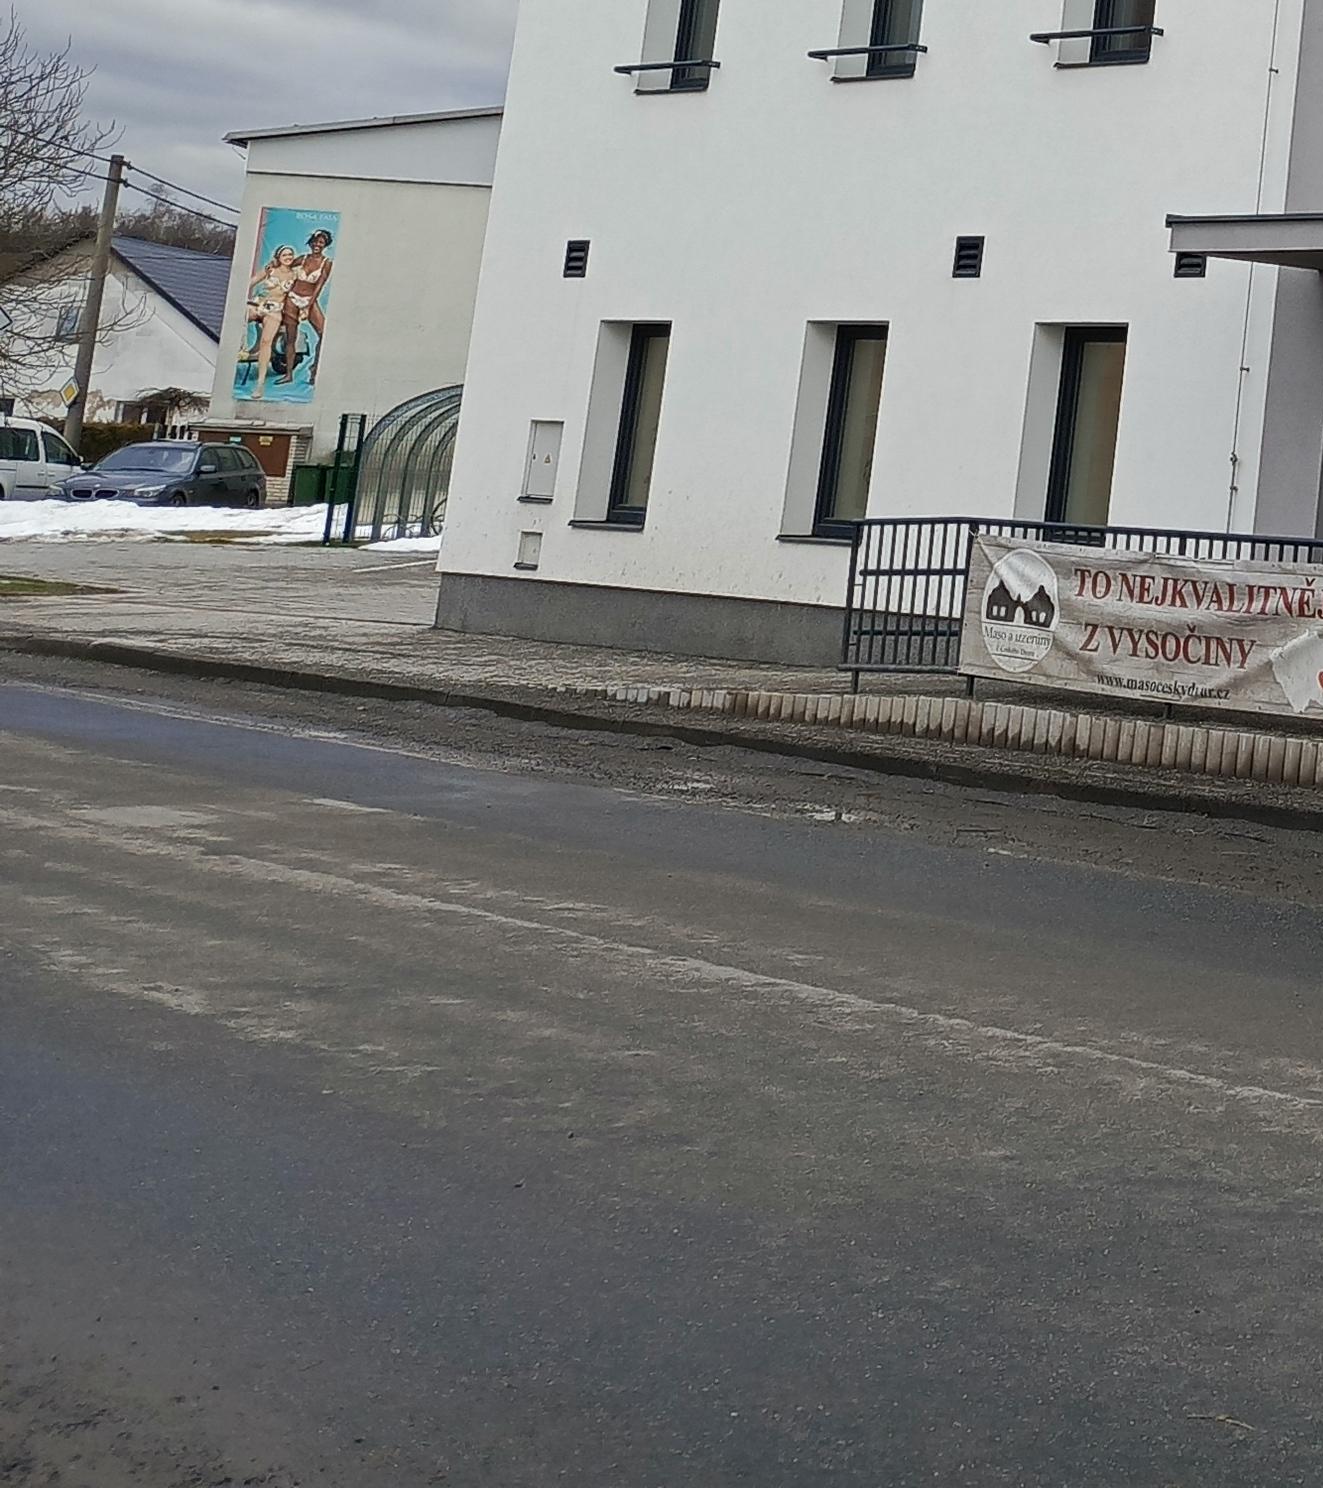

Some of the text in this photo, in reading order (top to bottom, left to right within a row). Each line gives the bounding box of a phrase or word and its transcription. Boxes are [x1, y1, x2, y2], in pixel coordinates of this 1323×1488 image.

[1074, 568, 1112, 600] TO
[984, 625, 1006, 640] Maso
[1079, 622, 1257, 670] Z VYSOČINY
